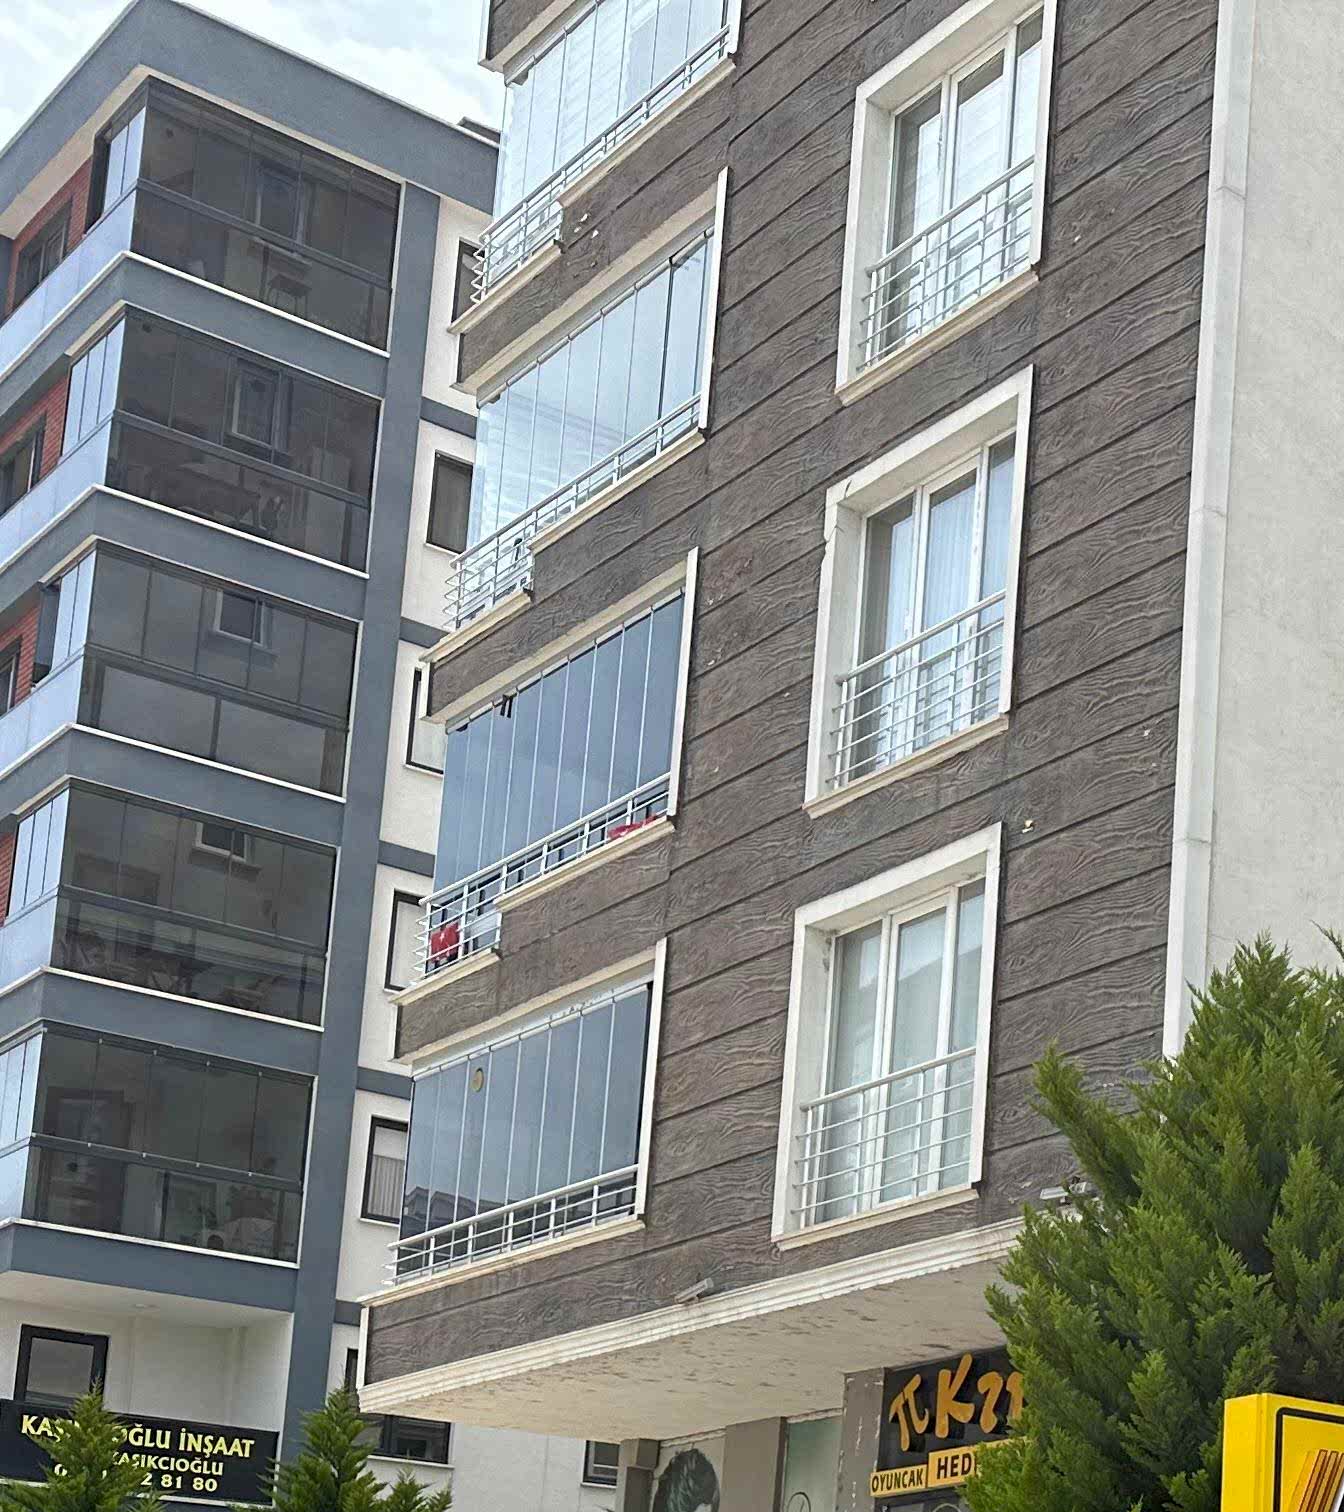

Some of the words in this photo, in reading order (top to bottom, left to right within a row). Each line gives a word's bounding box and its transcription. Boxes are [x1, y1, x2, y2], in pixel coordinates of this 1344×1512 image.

[179, 1428, 255, 1458] İNŞAAT
[936, 1452, 974, 1480] HED
[160, 1474, 183, 1489] 81
[192, 1477, 218, 1492] 80
[871, 1468, 924, 1493] OYUNCAK
